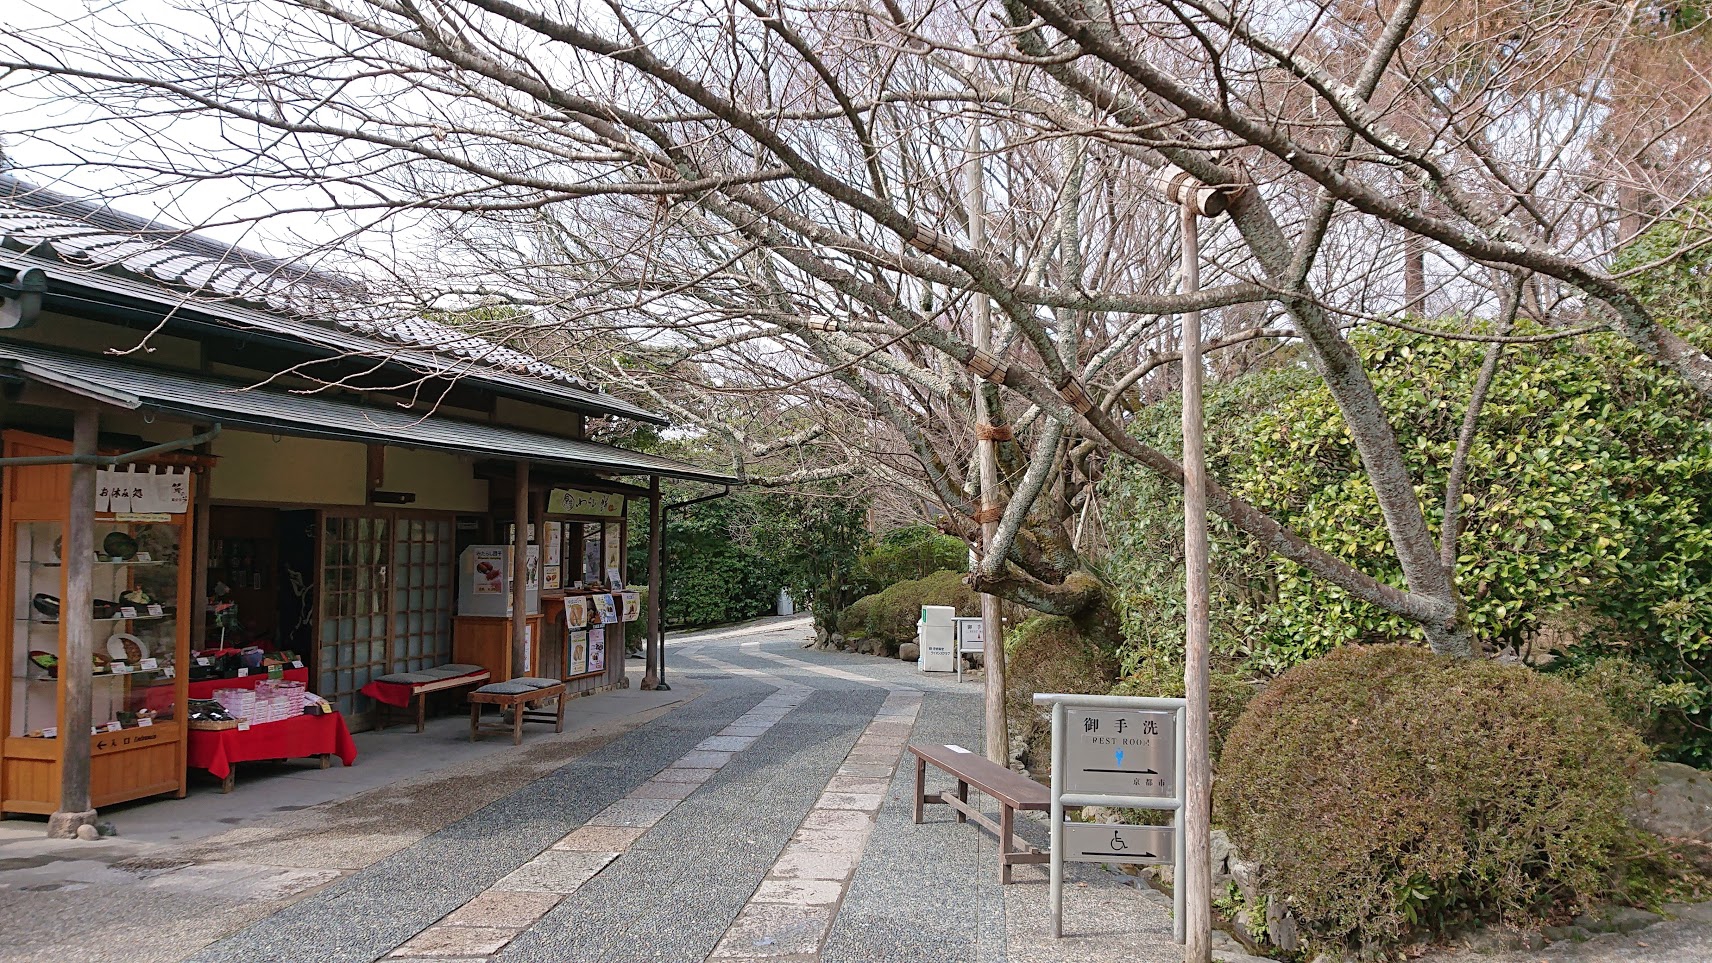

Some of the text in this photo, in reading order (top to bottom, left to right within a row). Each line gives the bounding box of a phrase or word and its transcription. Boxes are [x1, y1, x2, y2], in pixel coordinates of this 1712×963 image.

[99, 487, 143, 498] お休み処
[1083, 717, 1159, 735] 御手洗
[1092, 737, 1151, 746] REST ROOM
[1133, 777, 1165, 787] 京都市
